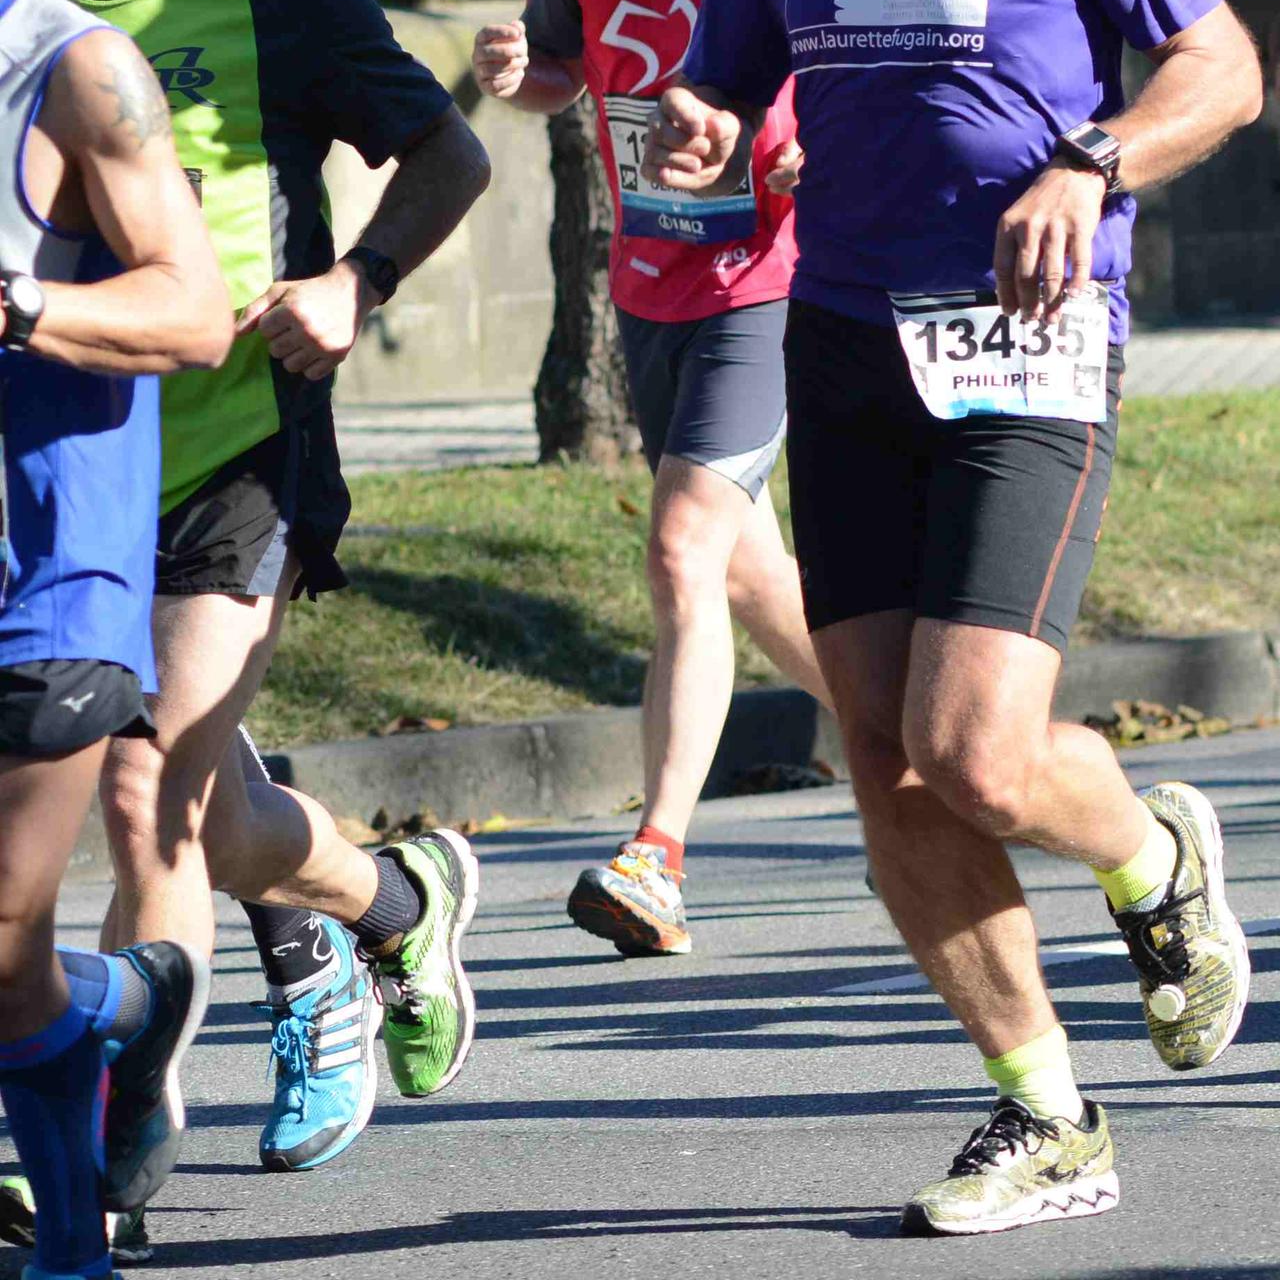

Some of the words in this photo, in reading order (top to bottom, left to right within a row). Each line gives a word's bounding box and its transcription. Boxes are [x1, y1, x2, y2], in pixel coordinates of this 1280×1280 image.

[671, 218, 707, 236] IMQ
[915, 313, 1086, 363] 13435
[953, 372, 1049, 389] PHILIPPE
